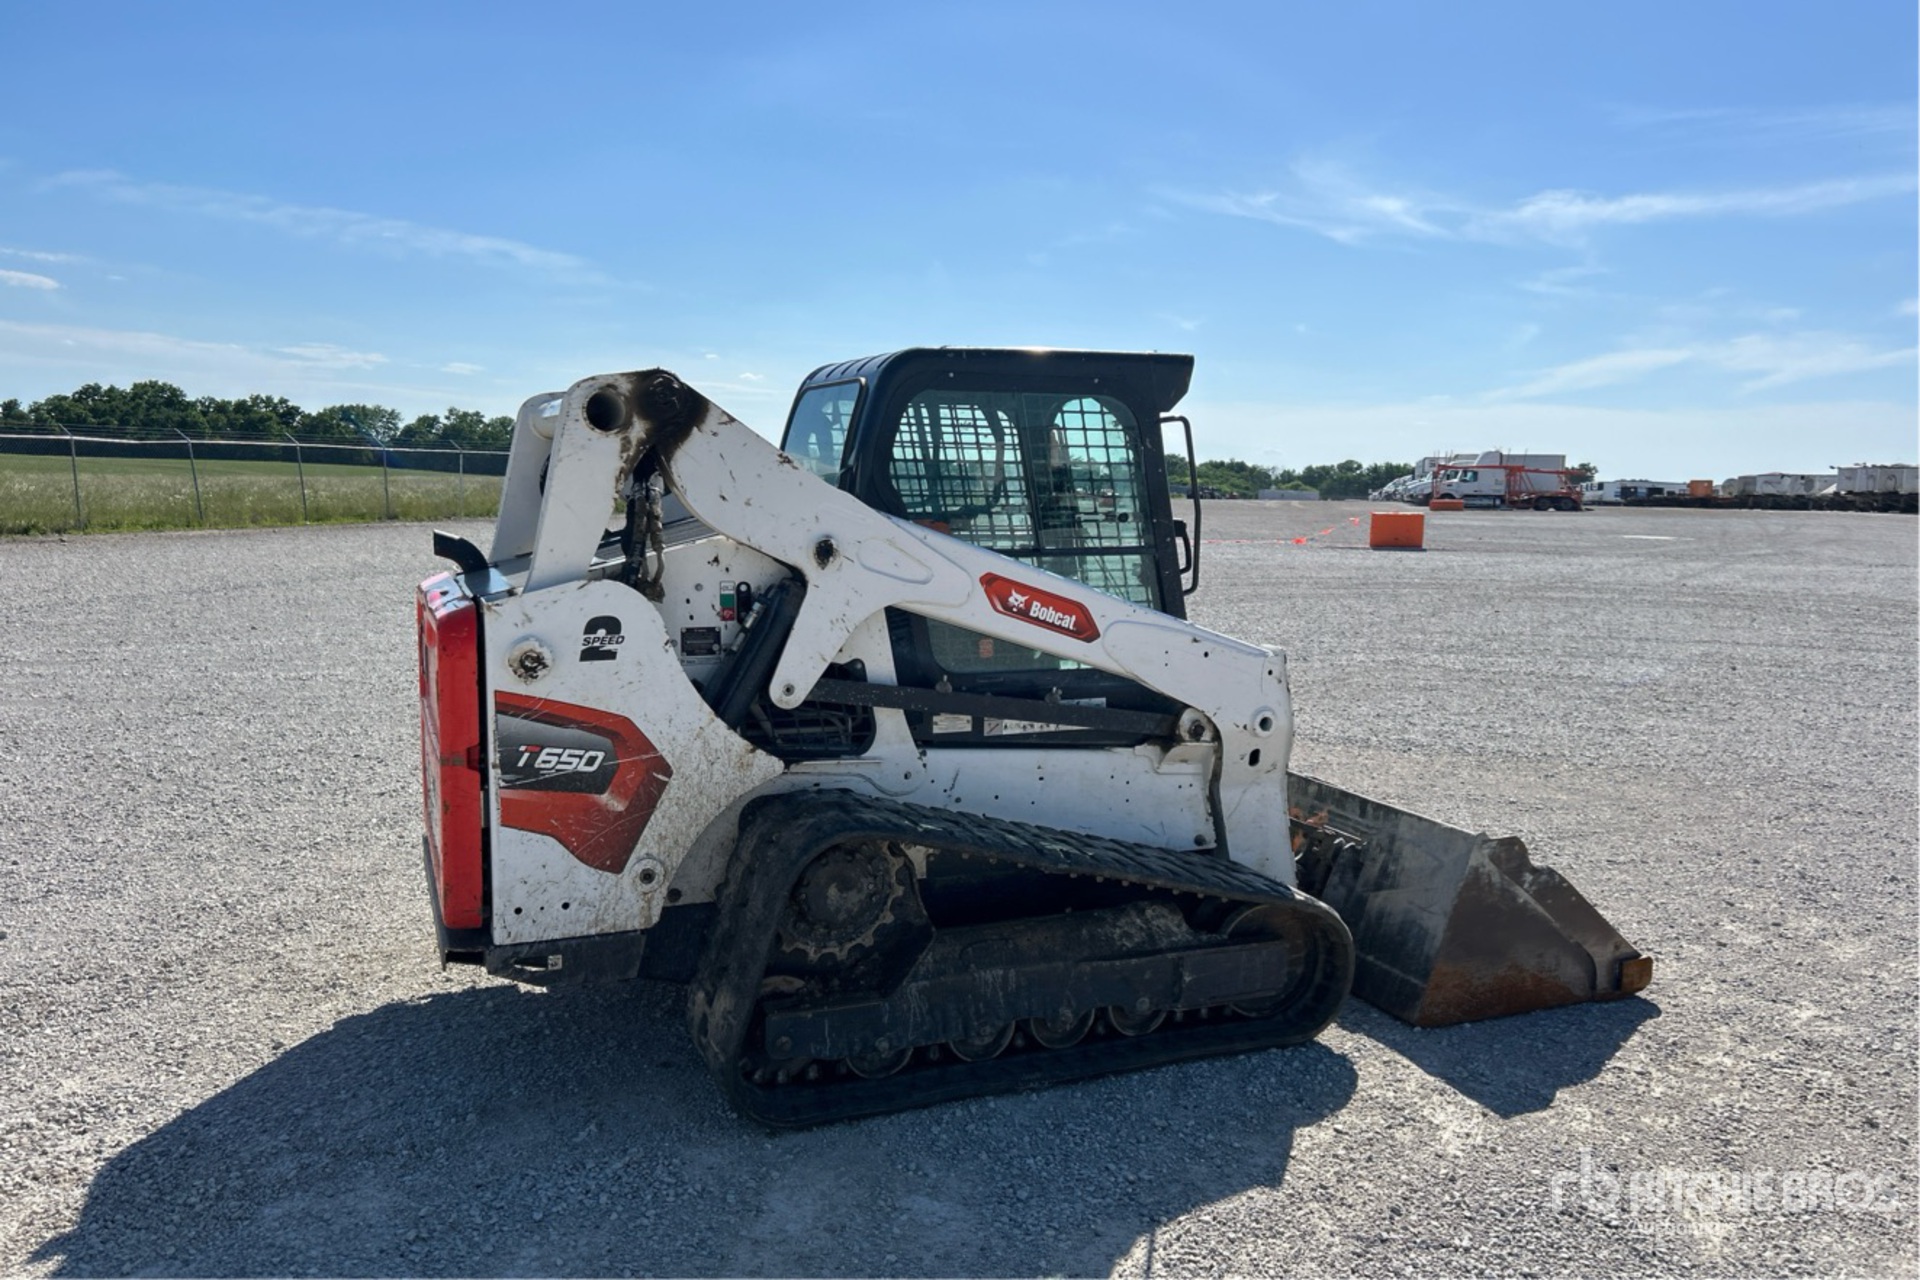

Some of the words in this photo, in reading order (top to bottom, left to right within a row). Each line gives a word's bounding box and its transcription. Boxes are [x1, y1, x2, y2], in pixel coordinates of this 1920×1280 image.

[1030, 600, 1076, 630] Bobcat
[579, 614, 622, 662] 2
[581, 635, 625, 647] SPEED
[517, 745, 606, 773] T650
